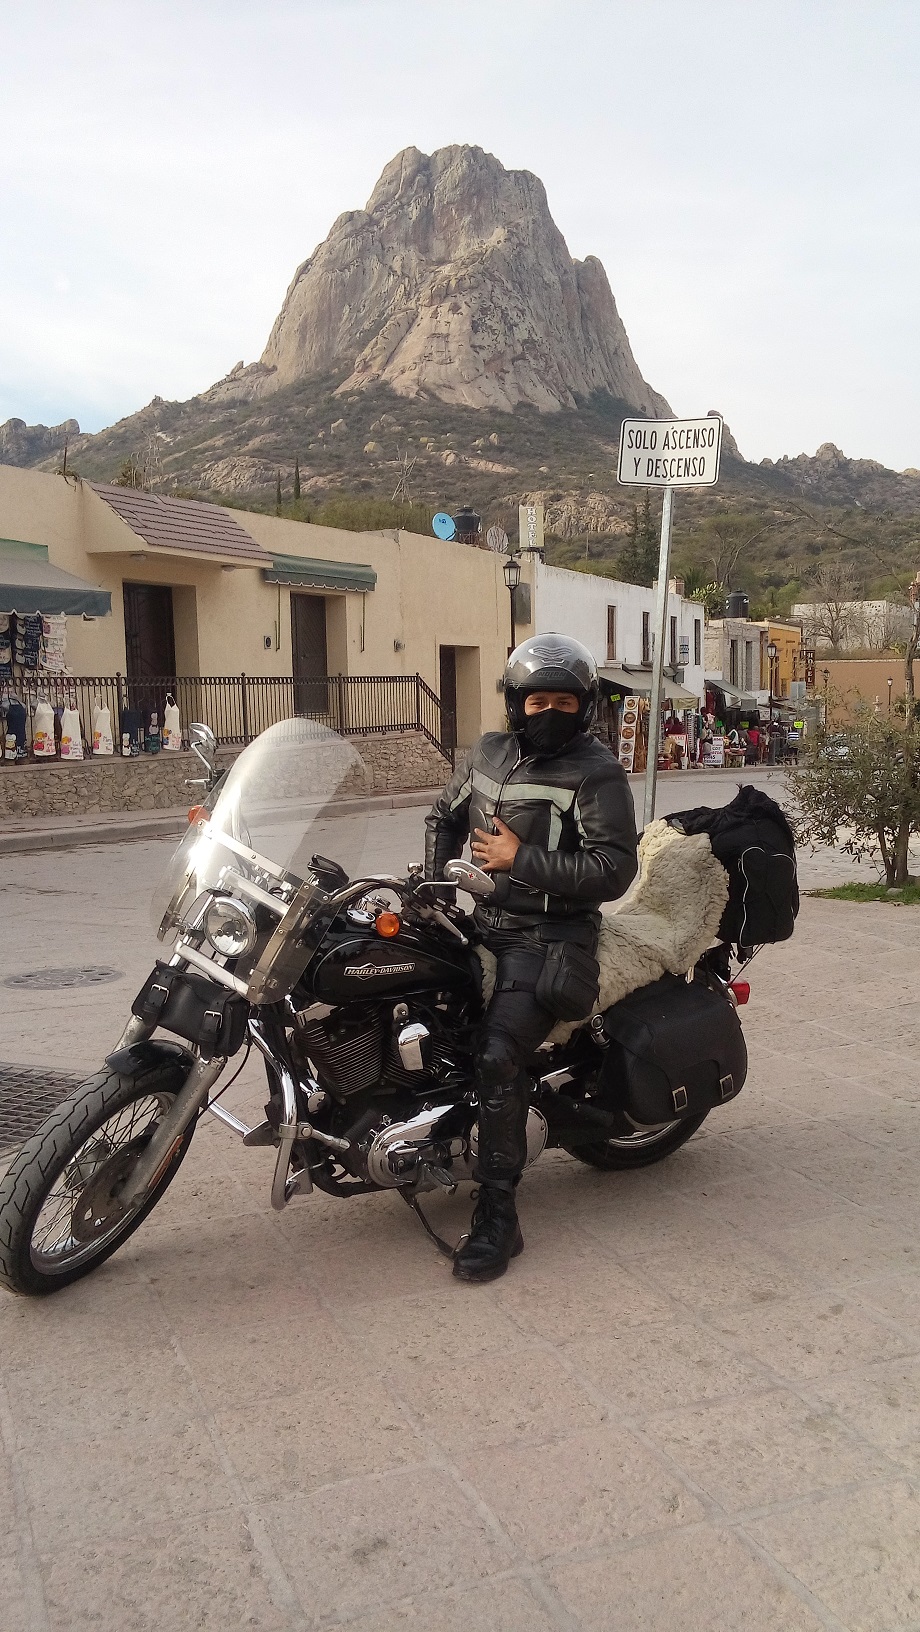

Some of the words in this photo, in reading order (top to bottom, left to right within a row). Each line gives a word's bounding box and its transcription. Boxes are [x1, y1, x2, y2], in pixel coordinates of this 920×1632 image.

[627, 429, 657, 450] SOLO
[662, 427, 715, 450] ASCENSO
[633, 457, 642, 476] Y
[646, 456, 706, 479] DESCENSO
[526, 507, 538, 546] HOTEL
[347, 964, 414, 975] HARLEY-DAVIDSON
